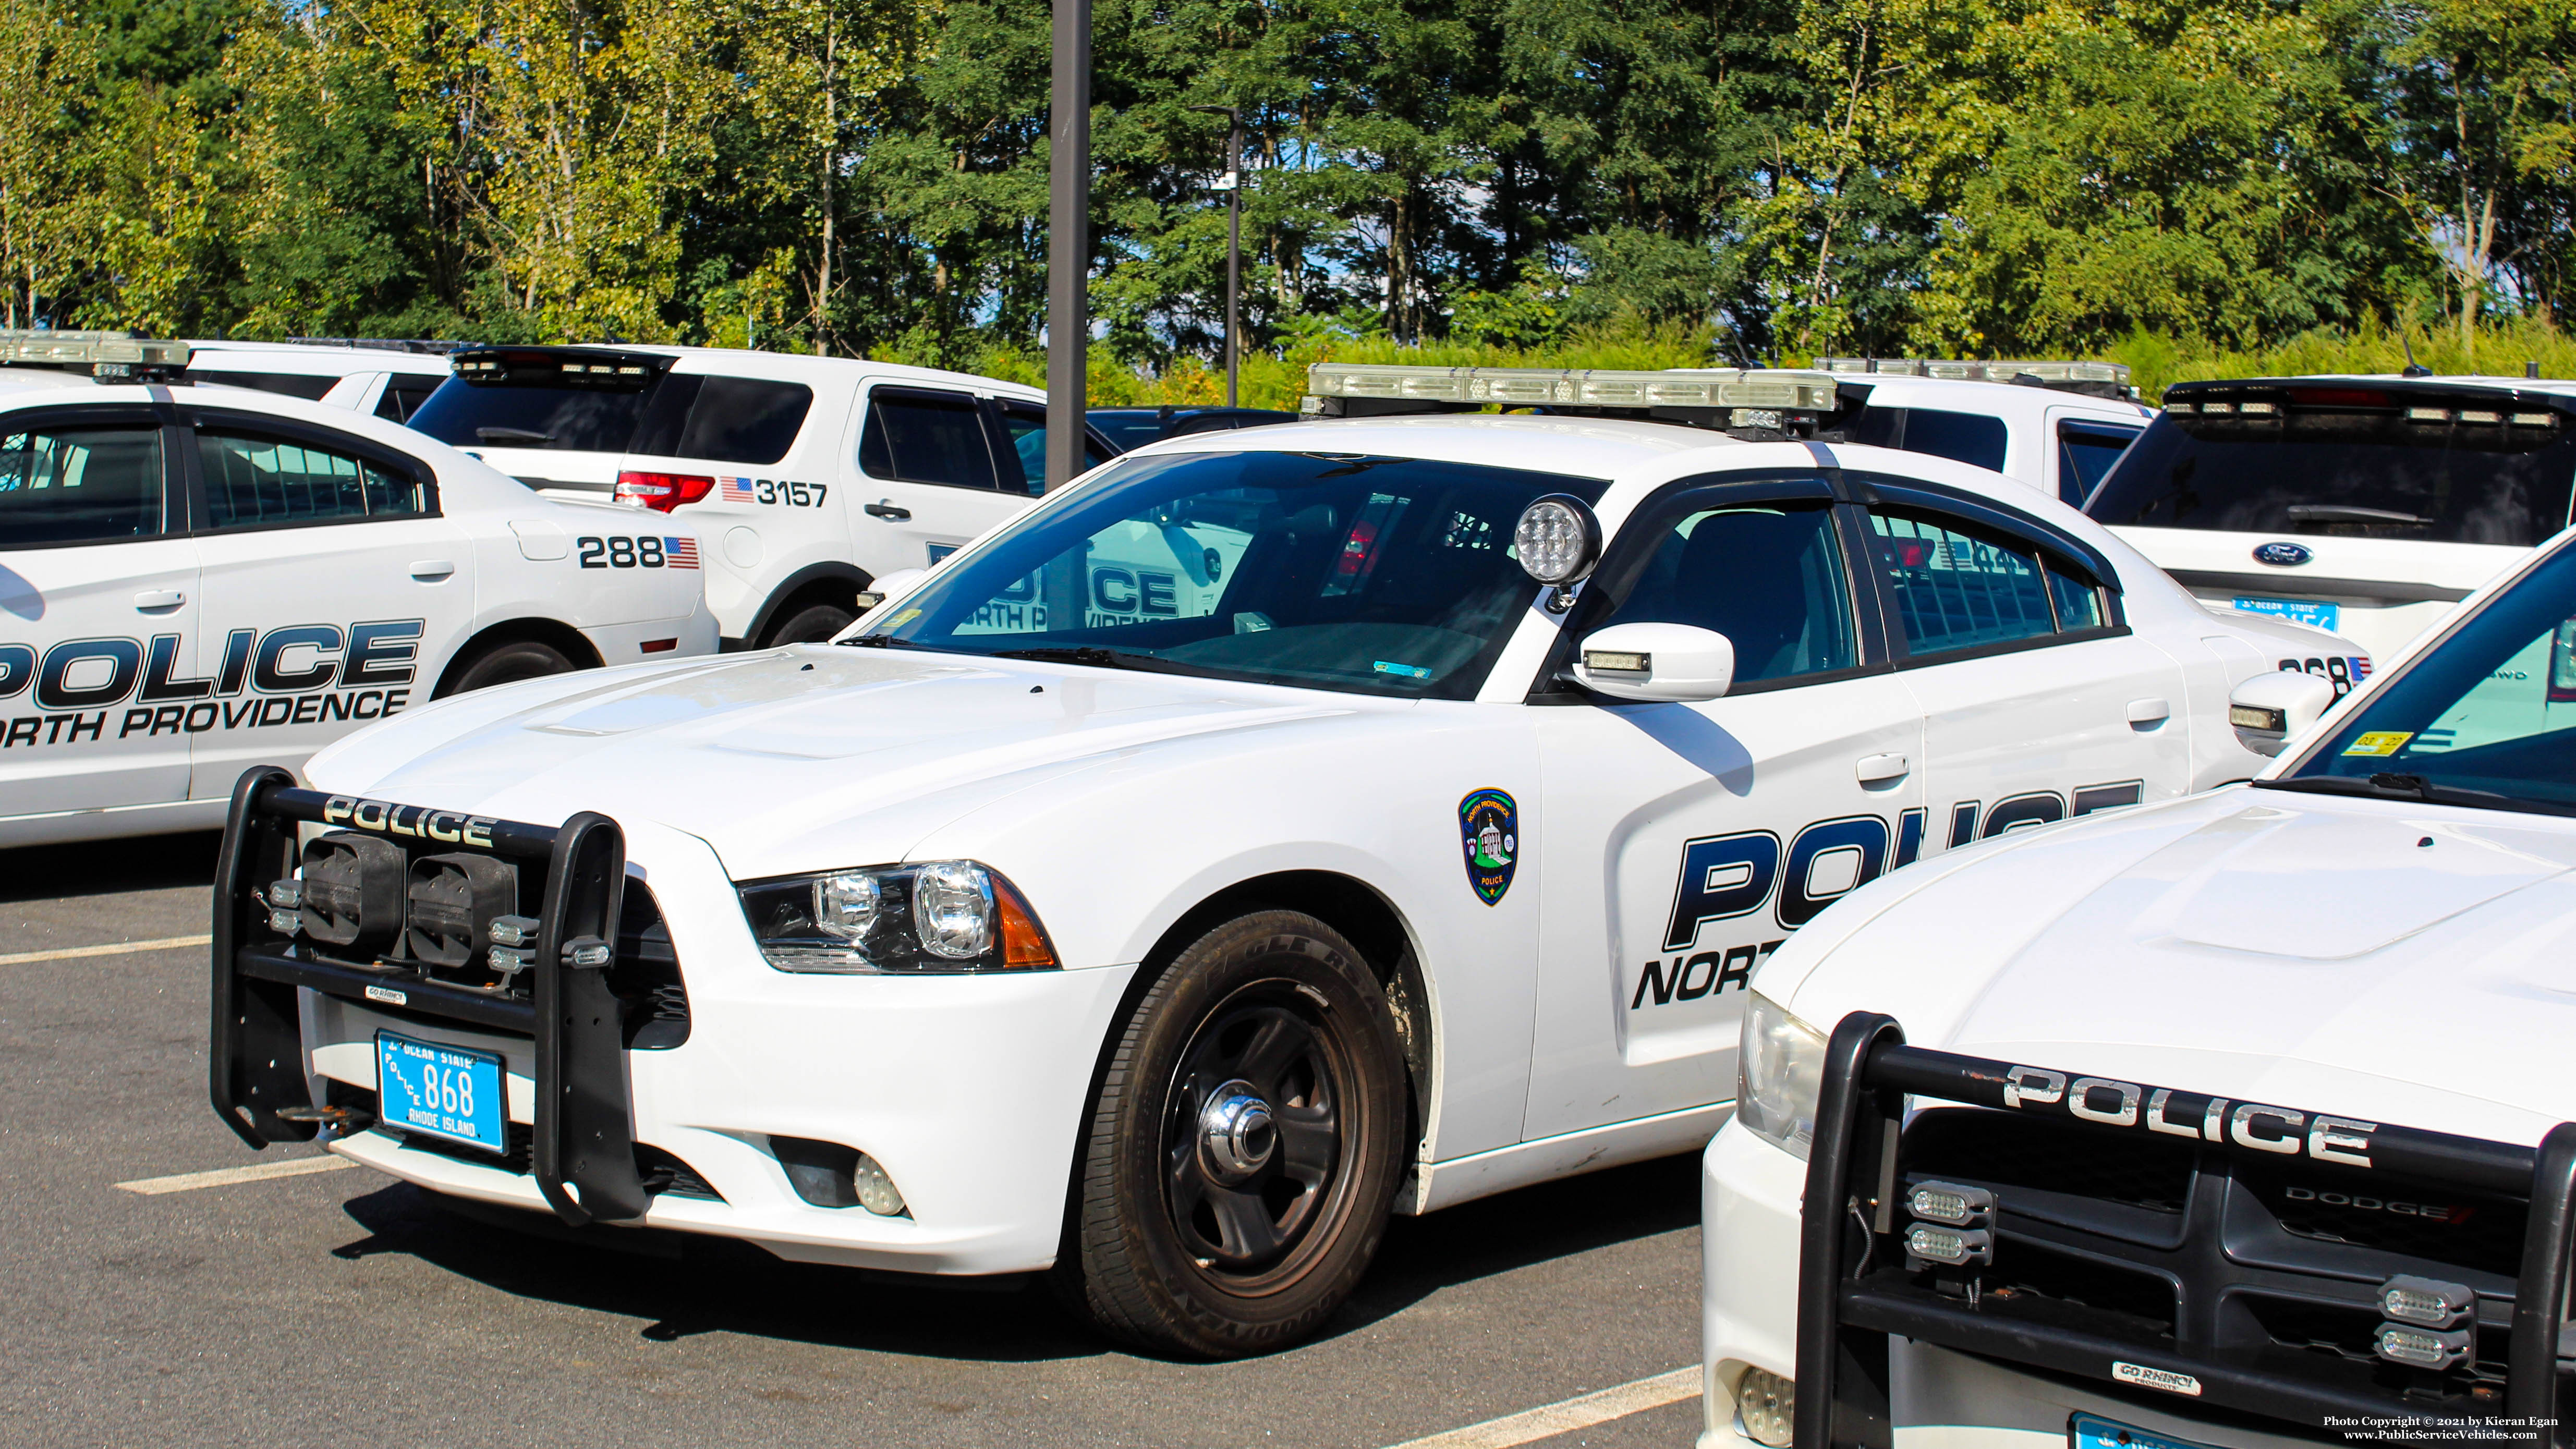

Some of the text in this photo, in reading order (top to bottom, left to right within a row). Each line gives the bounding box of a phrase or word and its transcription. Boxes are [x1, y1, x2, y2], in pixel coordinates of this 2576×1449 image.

[756, 479, 827, 508] 3157
[577, 536, 665, 568] 288
[2290, 604, 2314, 613] STATE
[0, 689, 411, 748] RTH PROVIDENCE
[324, 794, 501, 848] POLICE
[1467, 800, 1510, 823] NORTH PROVIDENCE
[1481, 875, 1503, 885] POLICE
[1631, 939, 1788, 1010] NOR
[404, 1044, 472, 1070] OCEAN STATE
[385, 1053, 421, 1106] POLICE
[423, 1064, 474, 1117] 868
[409, 1107, 476, 1138] RHODE ISLAND
[2003, 1065, 2378, 1168] POLICE
[2286, 1186, 2449, 1220] DODGE
[2120, 1364, 2140, 1377] GO
[2135, 1378, 2179, 1391] PRODUCTS
